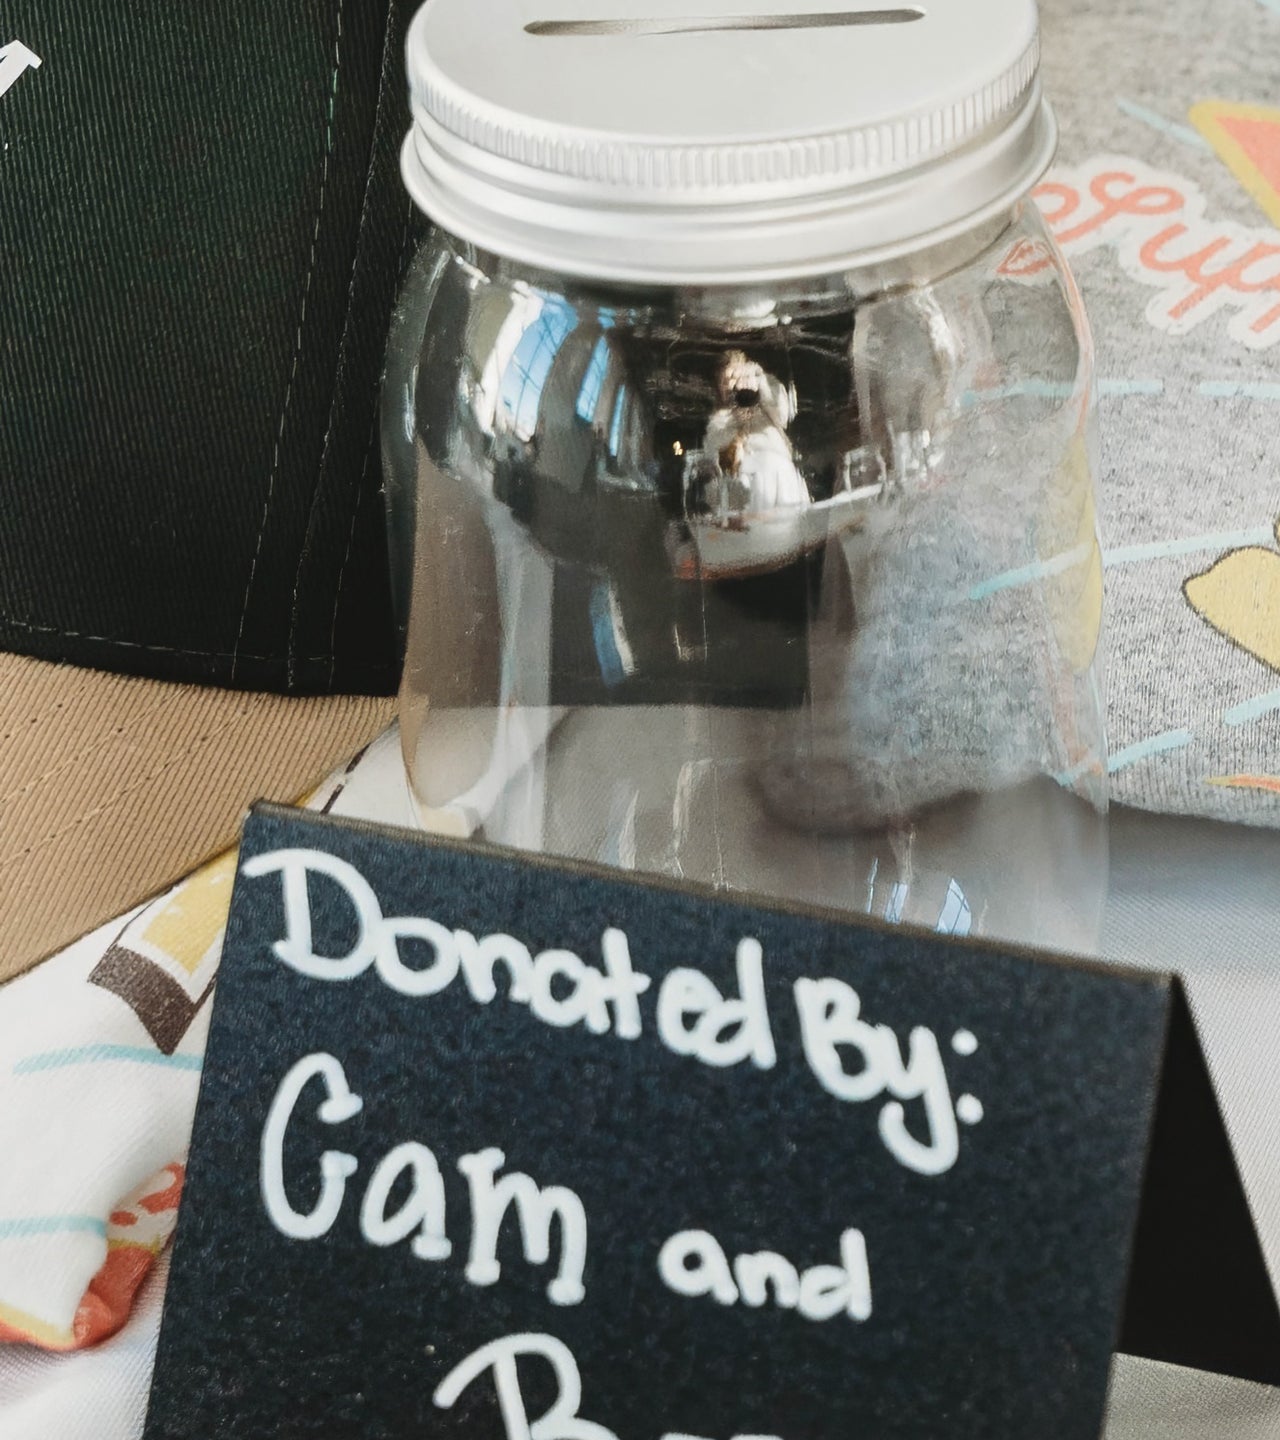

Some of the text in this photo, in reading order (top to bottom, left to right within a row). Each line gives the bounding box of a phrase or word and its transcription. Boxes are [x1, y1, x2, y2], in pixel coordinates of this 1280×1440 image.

[242, 849, 984, 1176] Donated By:
[260, 1052, 874, 1323] Cam and
